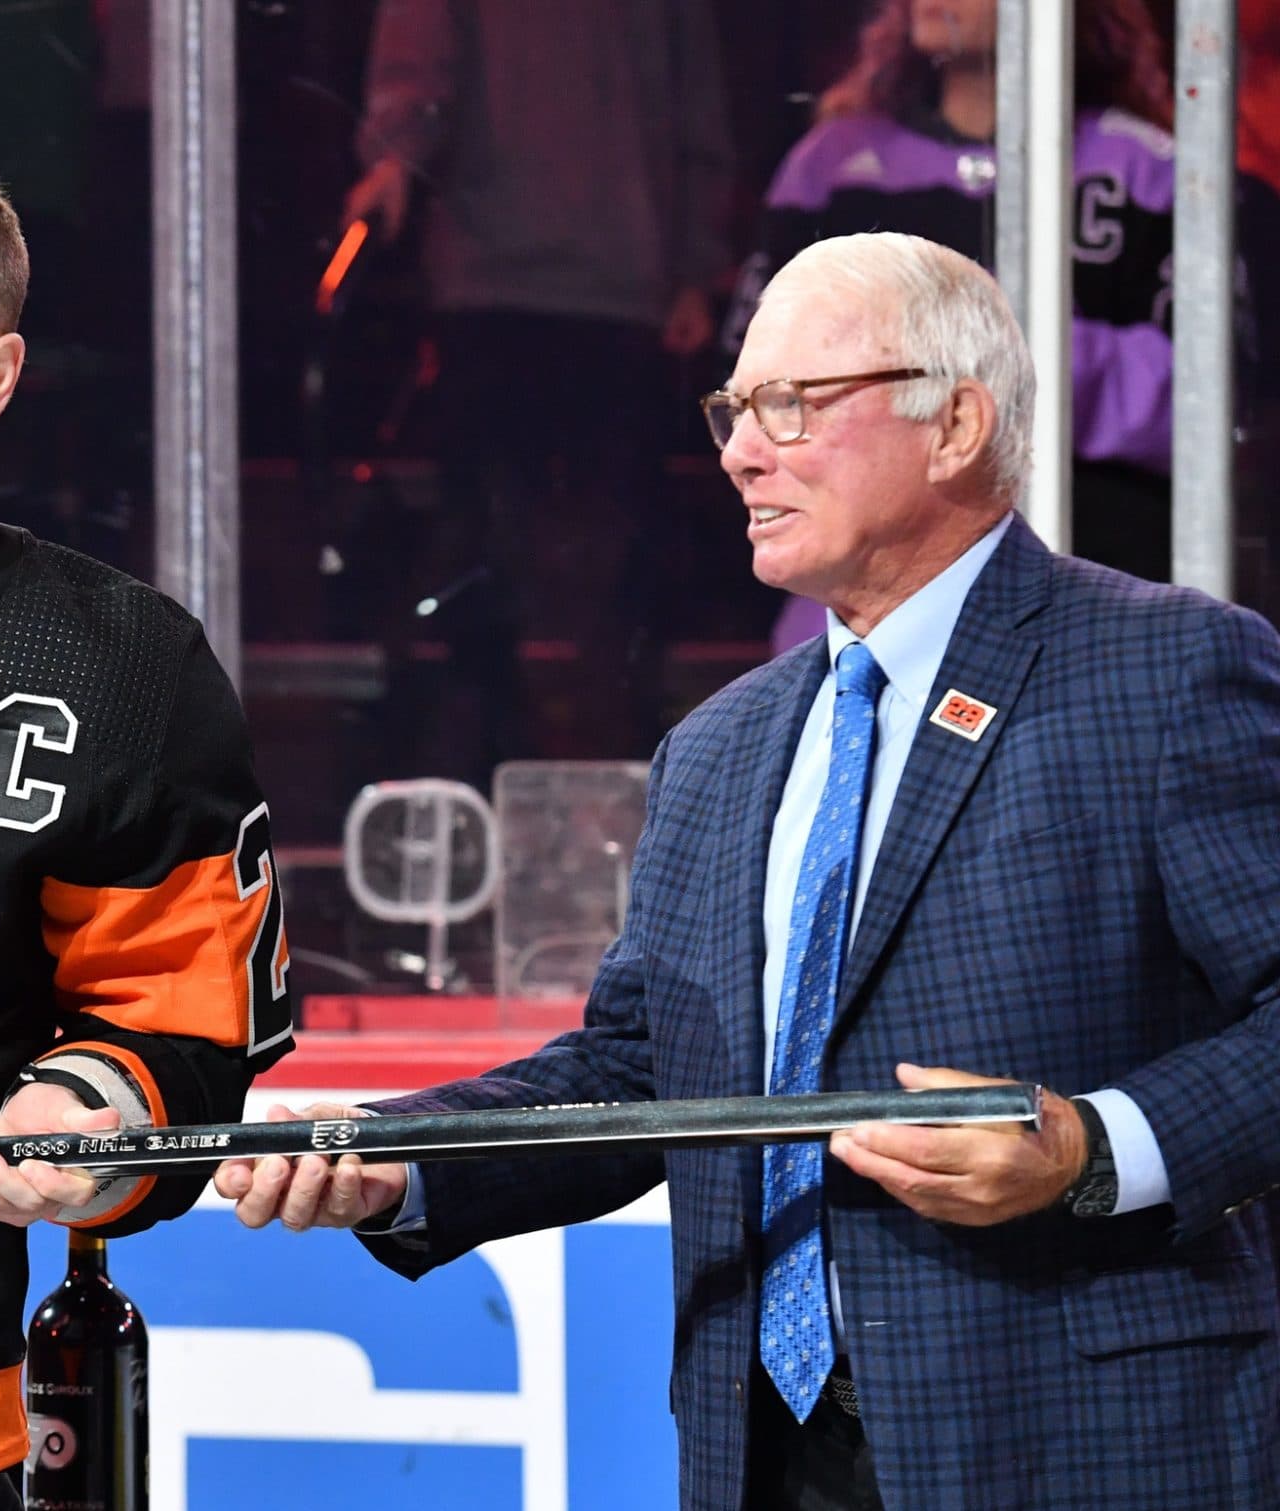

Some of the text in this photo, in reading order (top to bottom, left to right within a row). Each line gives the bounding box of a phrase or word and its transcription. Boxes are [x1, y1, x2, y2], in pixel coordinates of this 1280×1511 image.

[1073, 170, 1127, 264] C
[938, 696, 985, 730] 28
[12, 1133, 231, 1157] 1000 NHL GAMES
